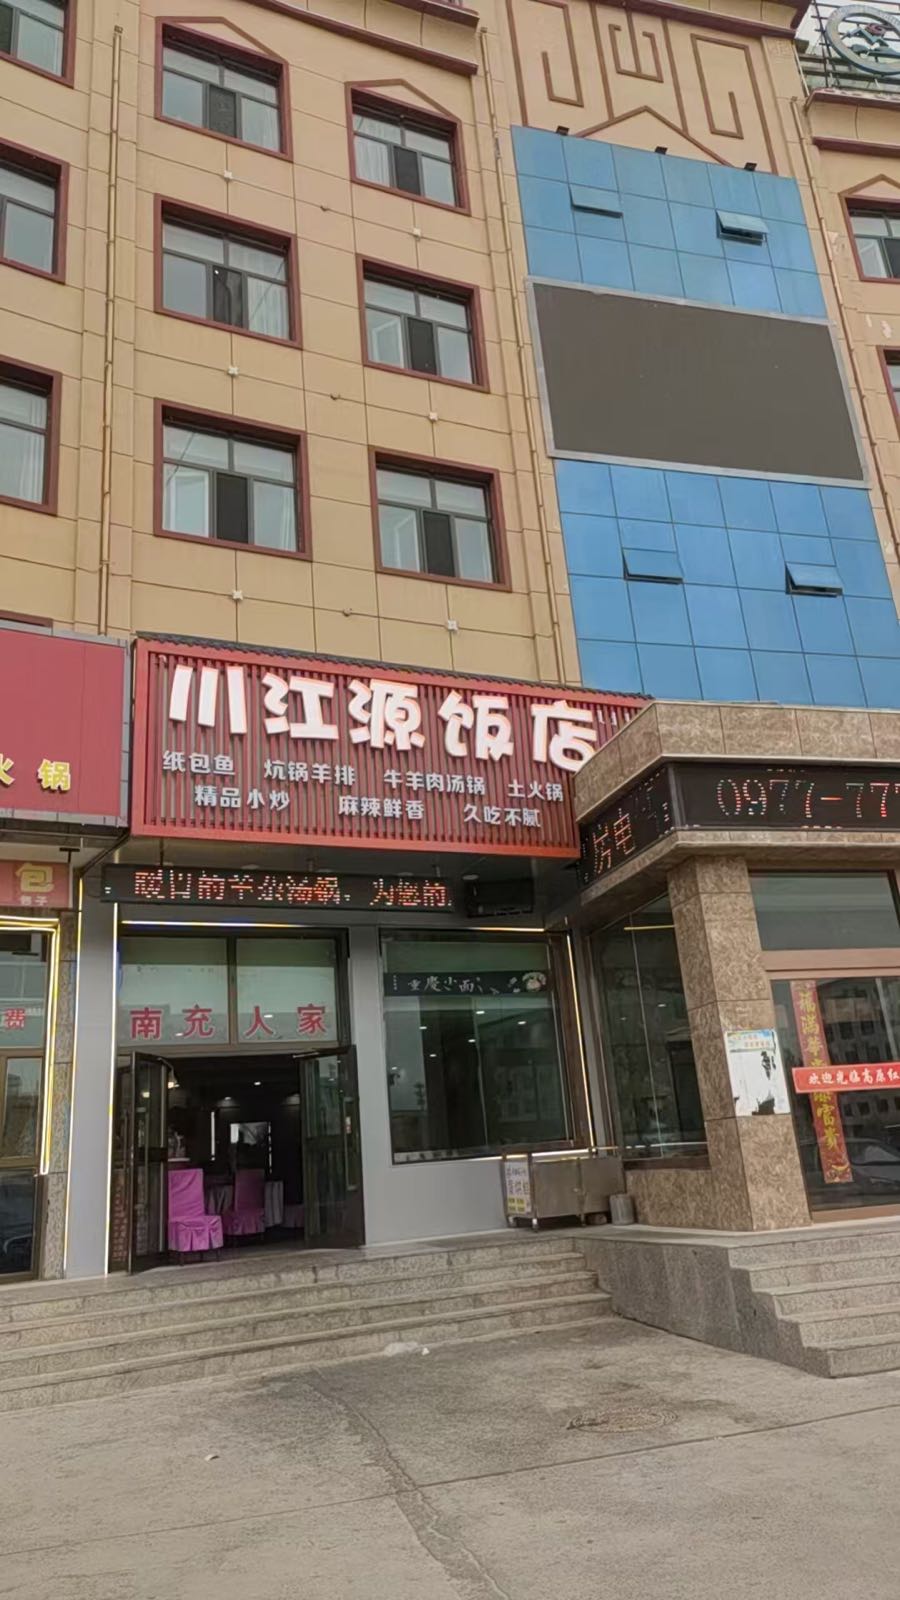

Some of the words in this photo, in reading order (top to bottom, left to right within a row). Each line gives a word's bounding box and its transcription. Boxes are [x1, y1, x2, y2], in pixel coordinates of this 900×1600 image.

[168, 664, 598, 772] 川江源饭店
[162, 750, 235, 776] 纸包鱼
[264, 759, 356, 786] 炕锅羊排
[384, 768, 486, 796] 牛羊肉汤锅
[507, 778, 564, 802] 土火锅
[194, 784, 291, 811] 精品小炒
[338, 795, 425, 821] 麻辣鲜香
[463, 803, 542, 829] 久吃不腻
[15, 862, 55, 893] 包
[129, 1003, 327, 1040] 南充人家
